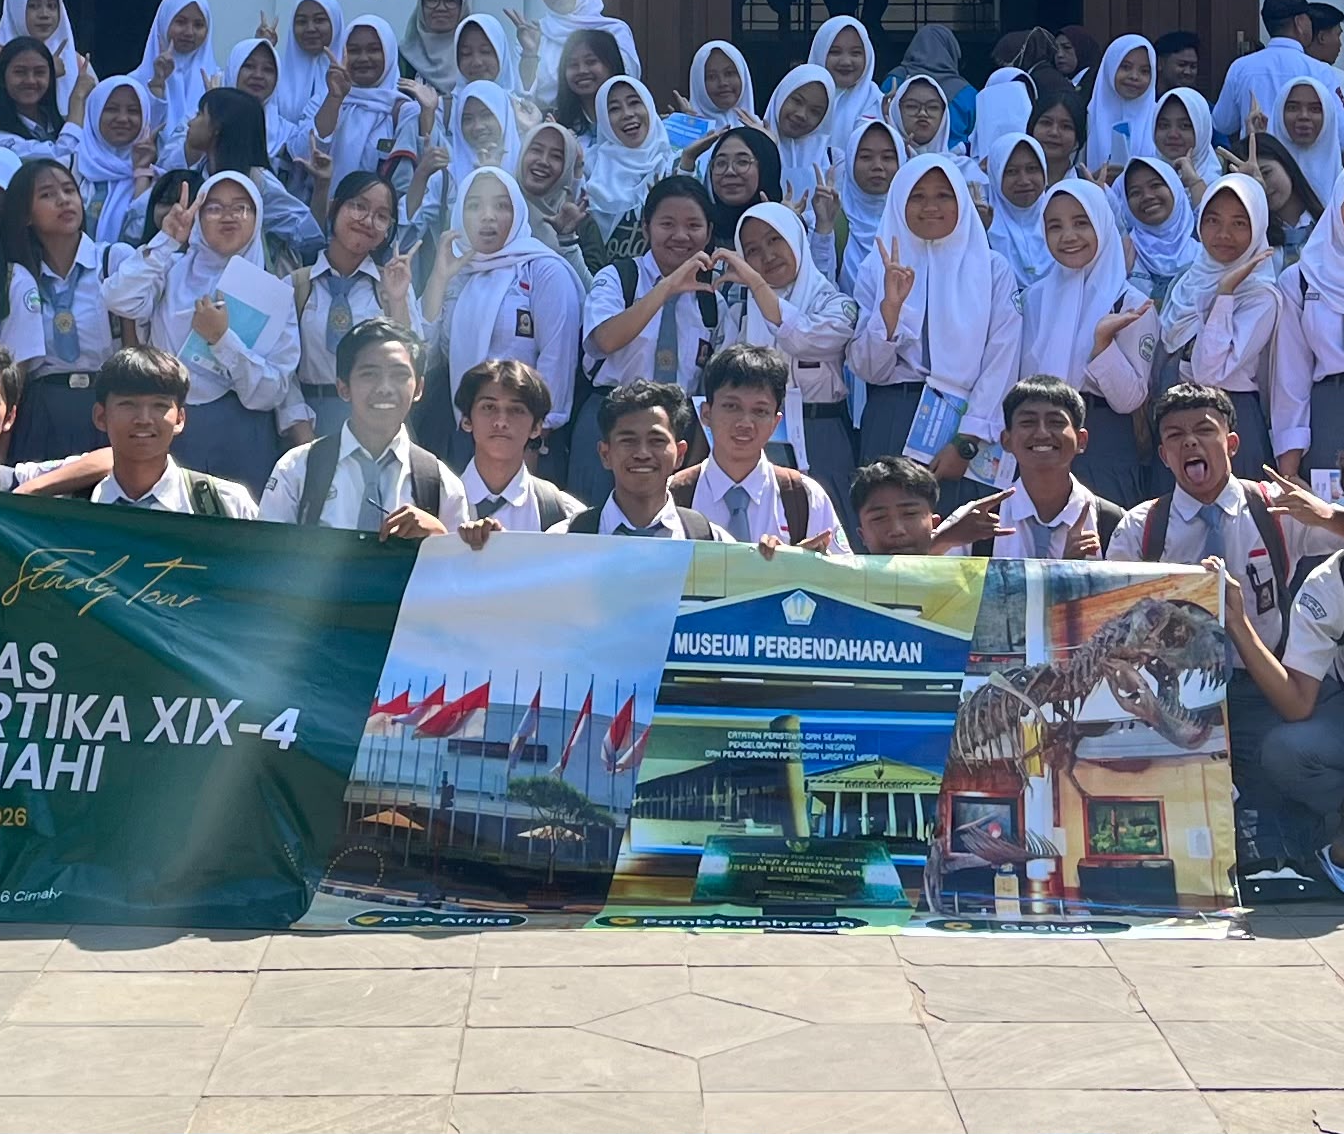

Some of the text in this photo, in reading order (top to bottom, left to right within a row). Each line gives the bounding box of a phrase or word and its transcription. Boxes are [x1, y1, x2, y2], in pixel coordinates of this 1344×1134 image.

[1, 548, 208, 617] Study Tour
[674, 632, 922, 663] MUSEUM PERBENDAHARAAN
[143, 695, 301, 750] XIX-4
[439, 916, 511, 925] Afrika
